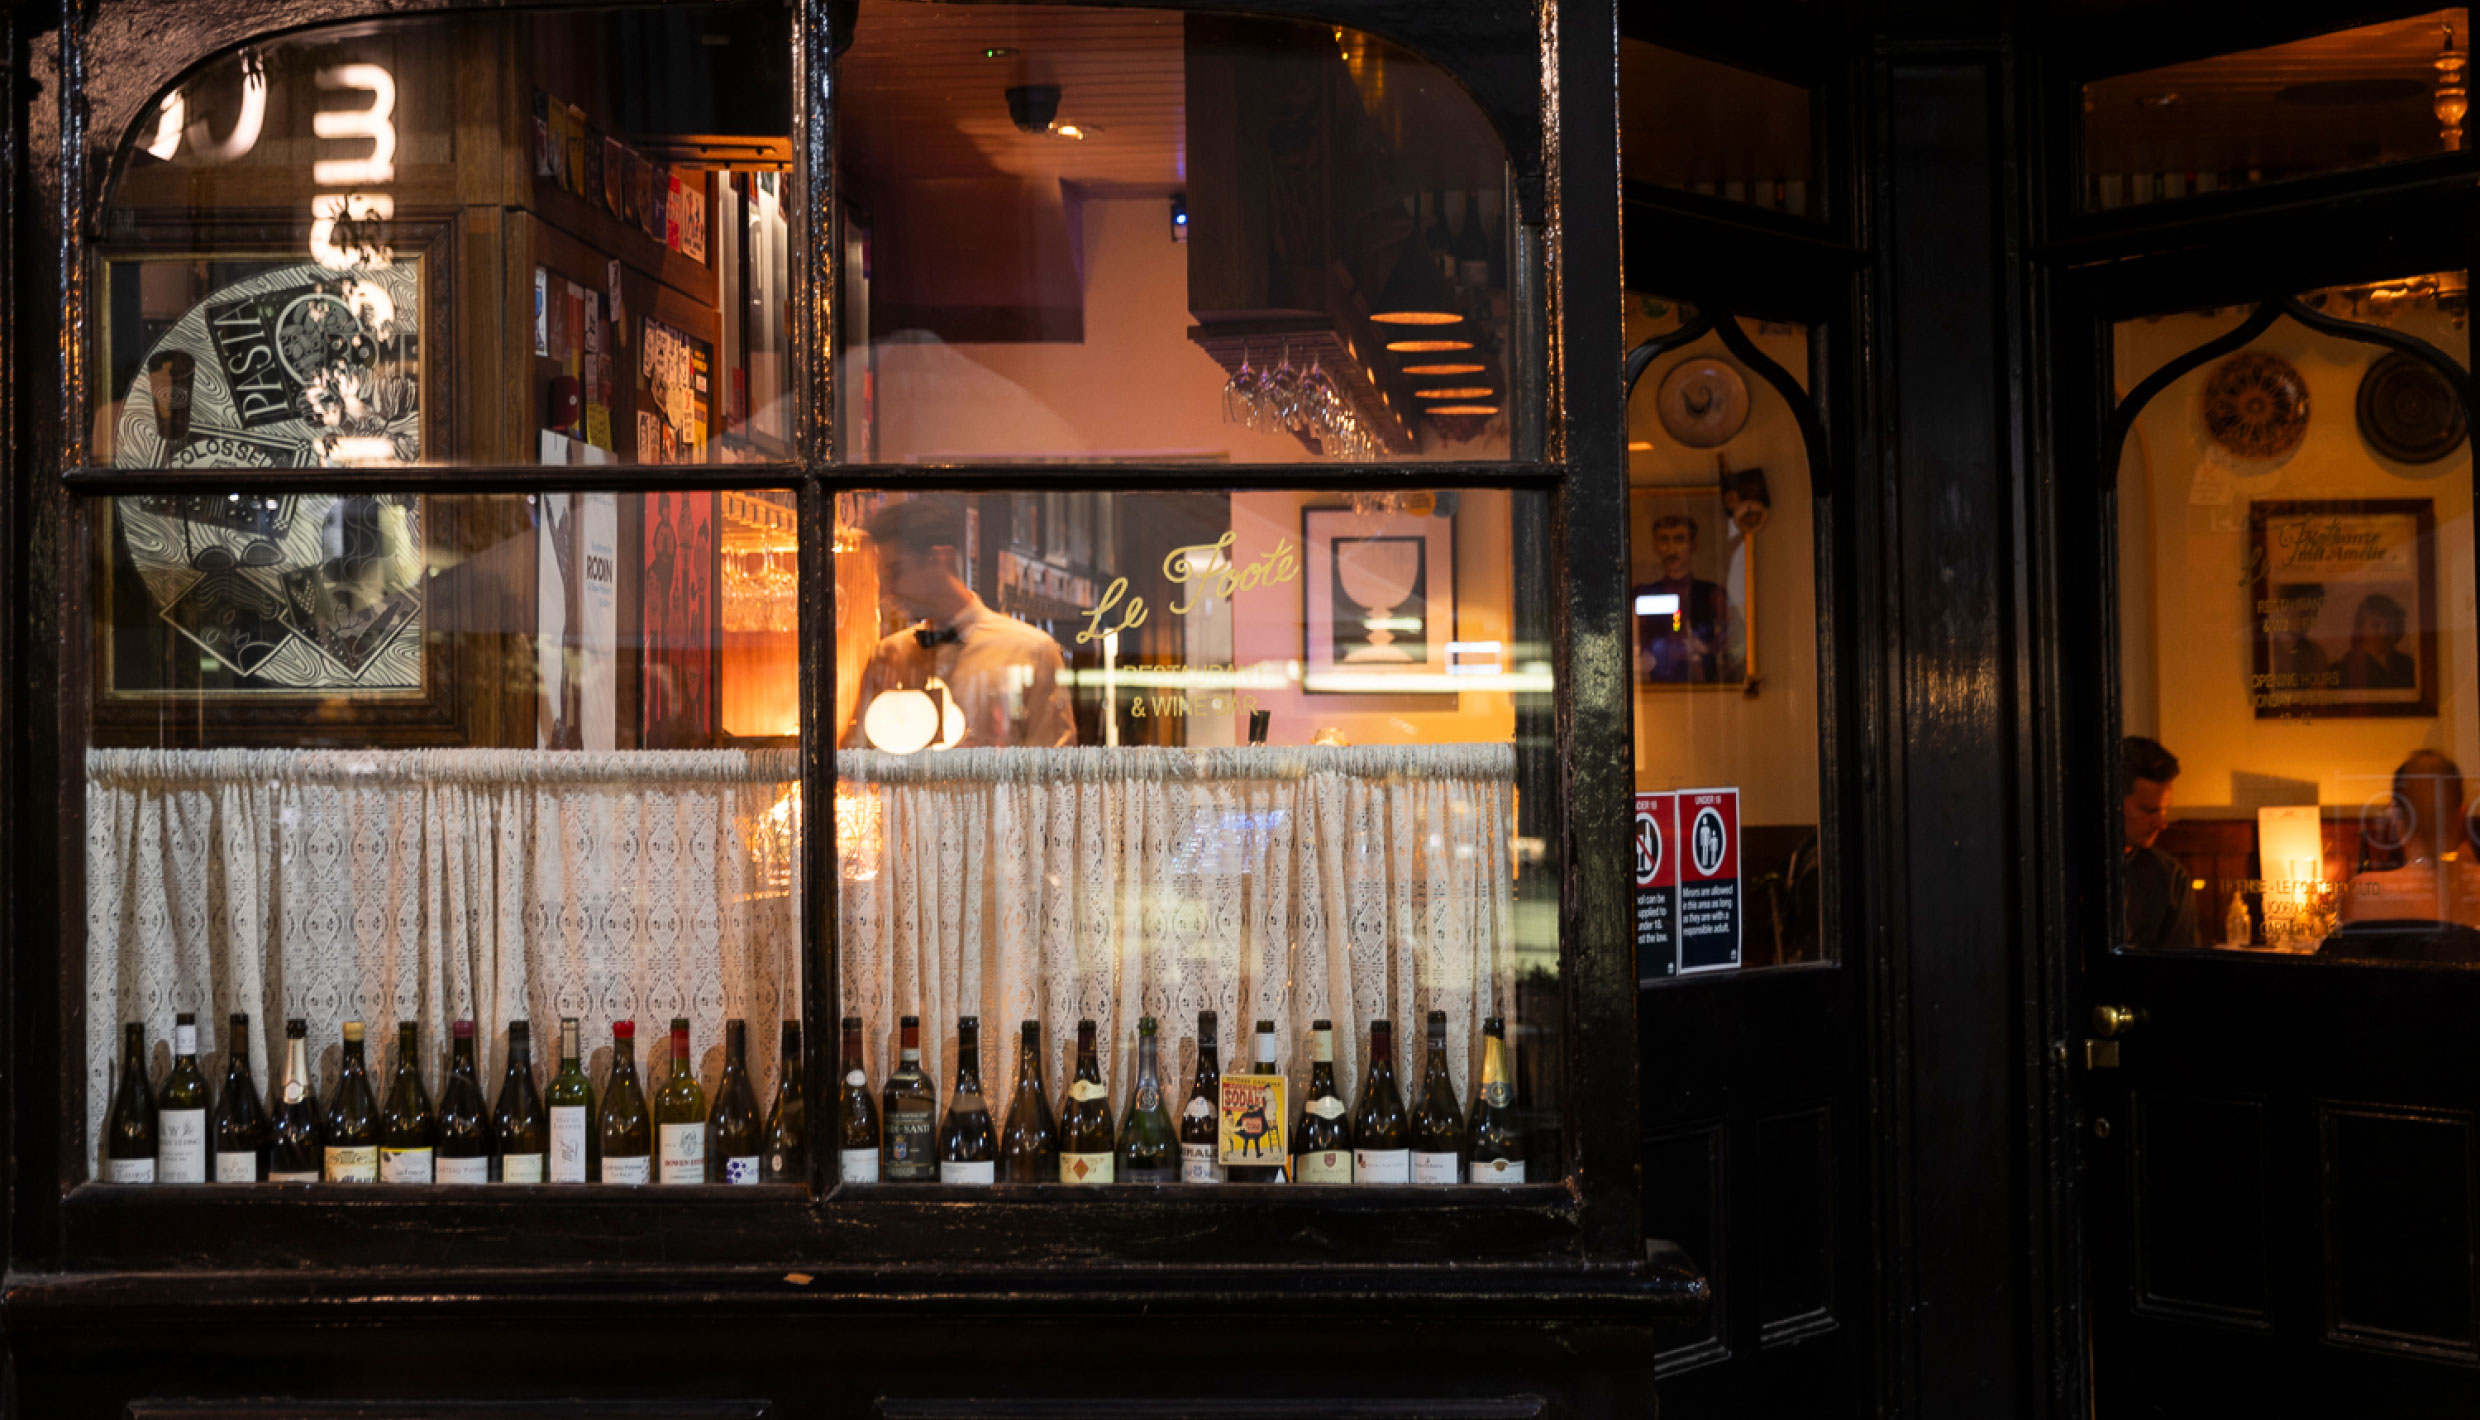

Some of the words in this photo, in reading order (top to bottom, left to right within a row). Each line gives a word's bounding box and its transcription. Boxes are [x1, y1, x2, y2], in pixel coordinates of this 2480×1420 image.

[212, 298, 289, 420] PASTA
[586, 554, 612, 584] RODIN
[1075, 577, 1148, 645] Le
[1163, 531, 1300, 615] Foote
[2301, 671, 2341, 687] HOURS
[1131, 696, 1147, 719] &
[1152, 696, 1208, 718] WINE
[1719, 897, 1732, 910] long
